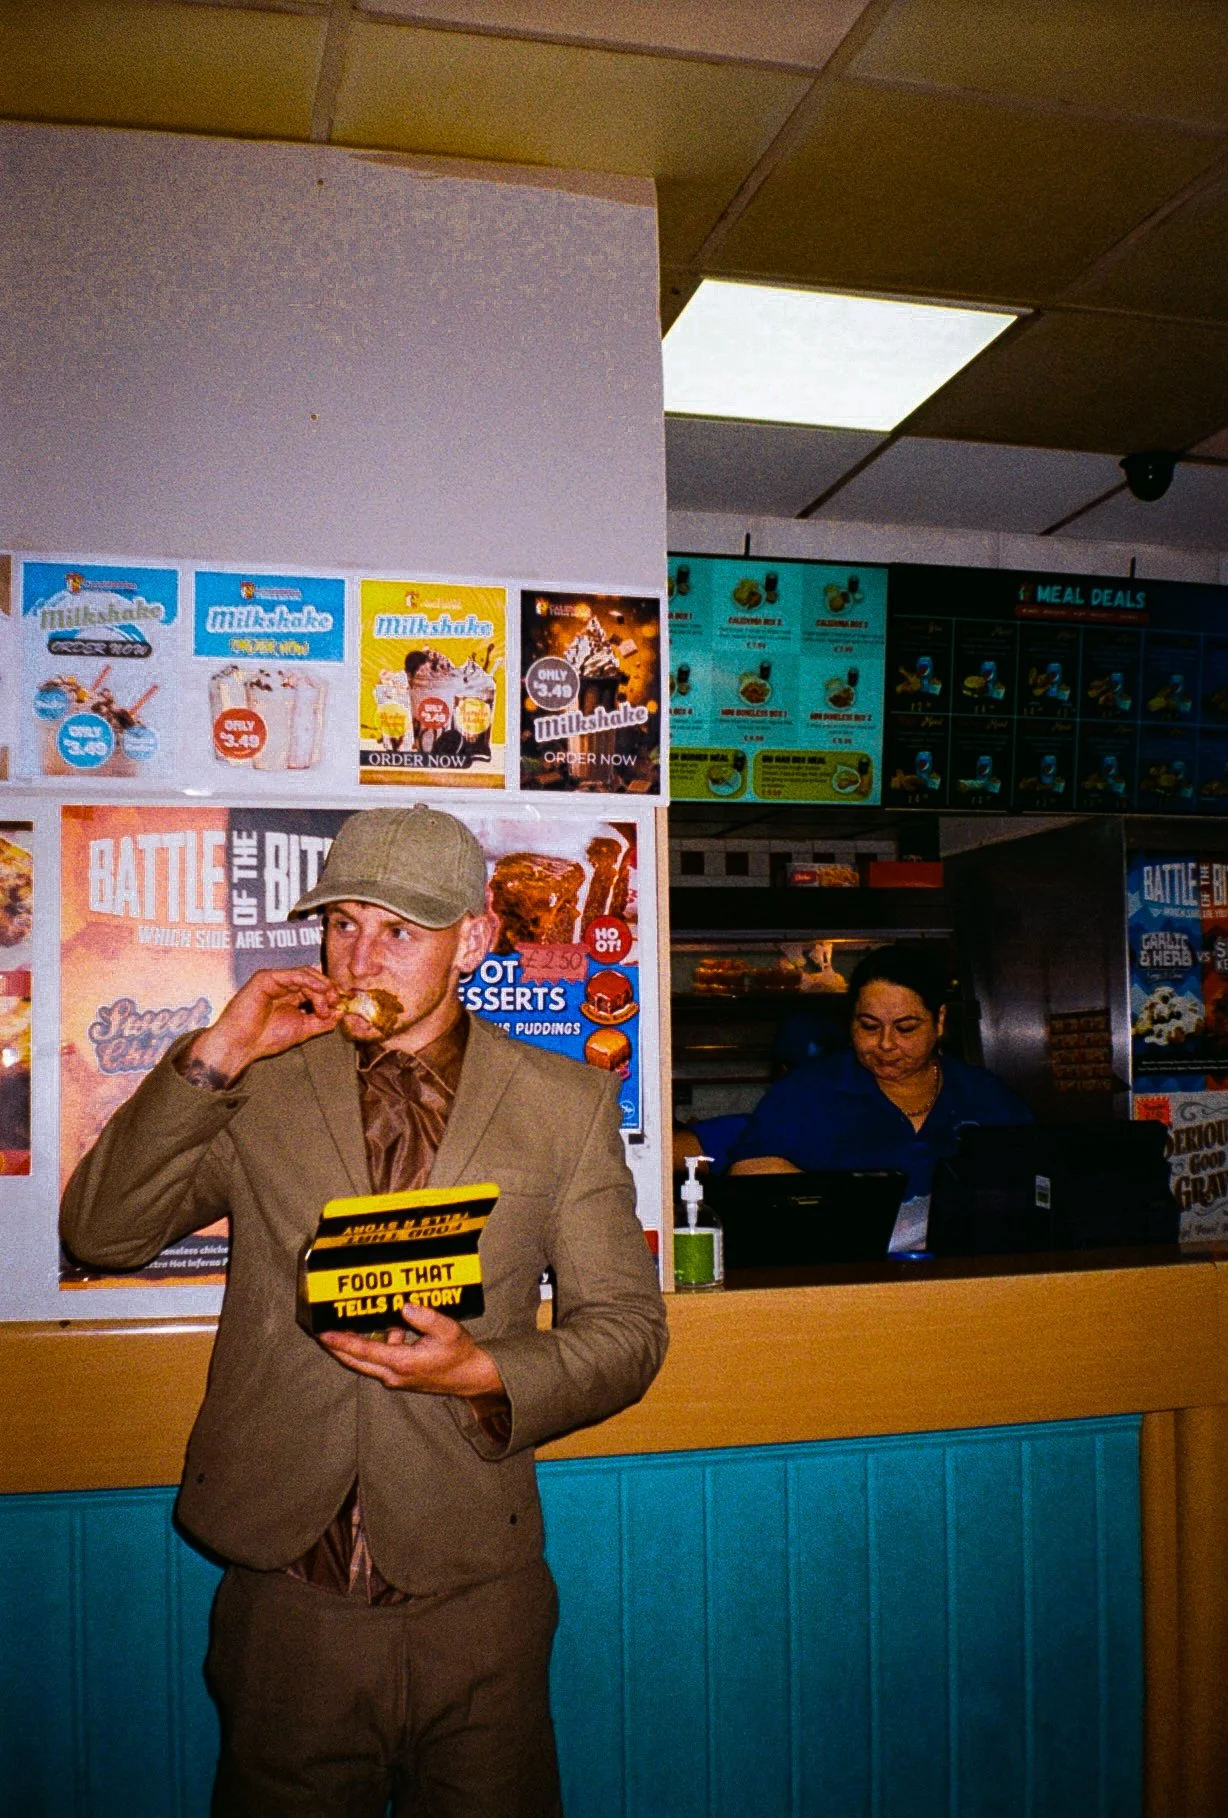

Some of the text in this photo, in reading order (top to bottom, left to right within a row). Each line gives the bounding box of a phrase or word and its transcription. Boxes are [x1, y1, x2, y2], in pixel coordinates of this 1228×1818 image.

[1037, 585, 1146, 608] MEAL DEALS
[41, 598, 162, 629] Milkshake
[210, 606, 331, 631] Milkshake
[376, 615, 492, 636] Milkshake
[538, 670, 567, 681] ONLY
[224, 720, 255, 732] ONLY
[537, 703, 646, 739] Milkshake
[369, 753, 467, 768] ORDER NOW
[544, 752, 637, 766] ORDER NOW
[232, 830, 258, 884] THE
[90, 830, 225, 923] BATTLE
[1143, 862, 1198, 906] BATTLE
[1213, 863, 1228, 906] BI
[232, 889, 258, 926] OF
[138, 925, 324, 949] WHICH SIDE ARE YOU ON
[595, 928, 619, 940] HO
[1142, 931, 1189, 950] GARLIC
[595, 939, 621, 953] OT!
[1140, 950, 1192, 967] & HERB
[515, 1022, 581, 1035] PUDDINGS
[1173, 1169, 1228, 1211] GRAV
[342, 1220, 399, 1236] STORY
[408, 1223, 463, 1238] FOOD
[169, 1259, 186, 1268] Hot
[337, 1263, 455, 1293] FOOD THAT
[333, 1287, 463, 1318] TELLS A STORY
